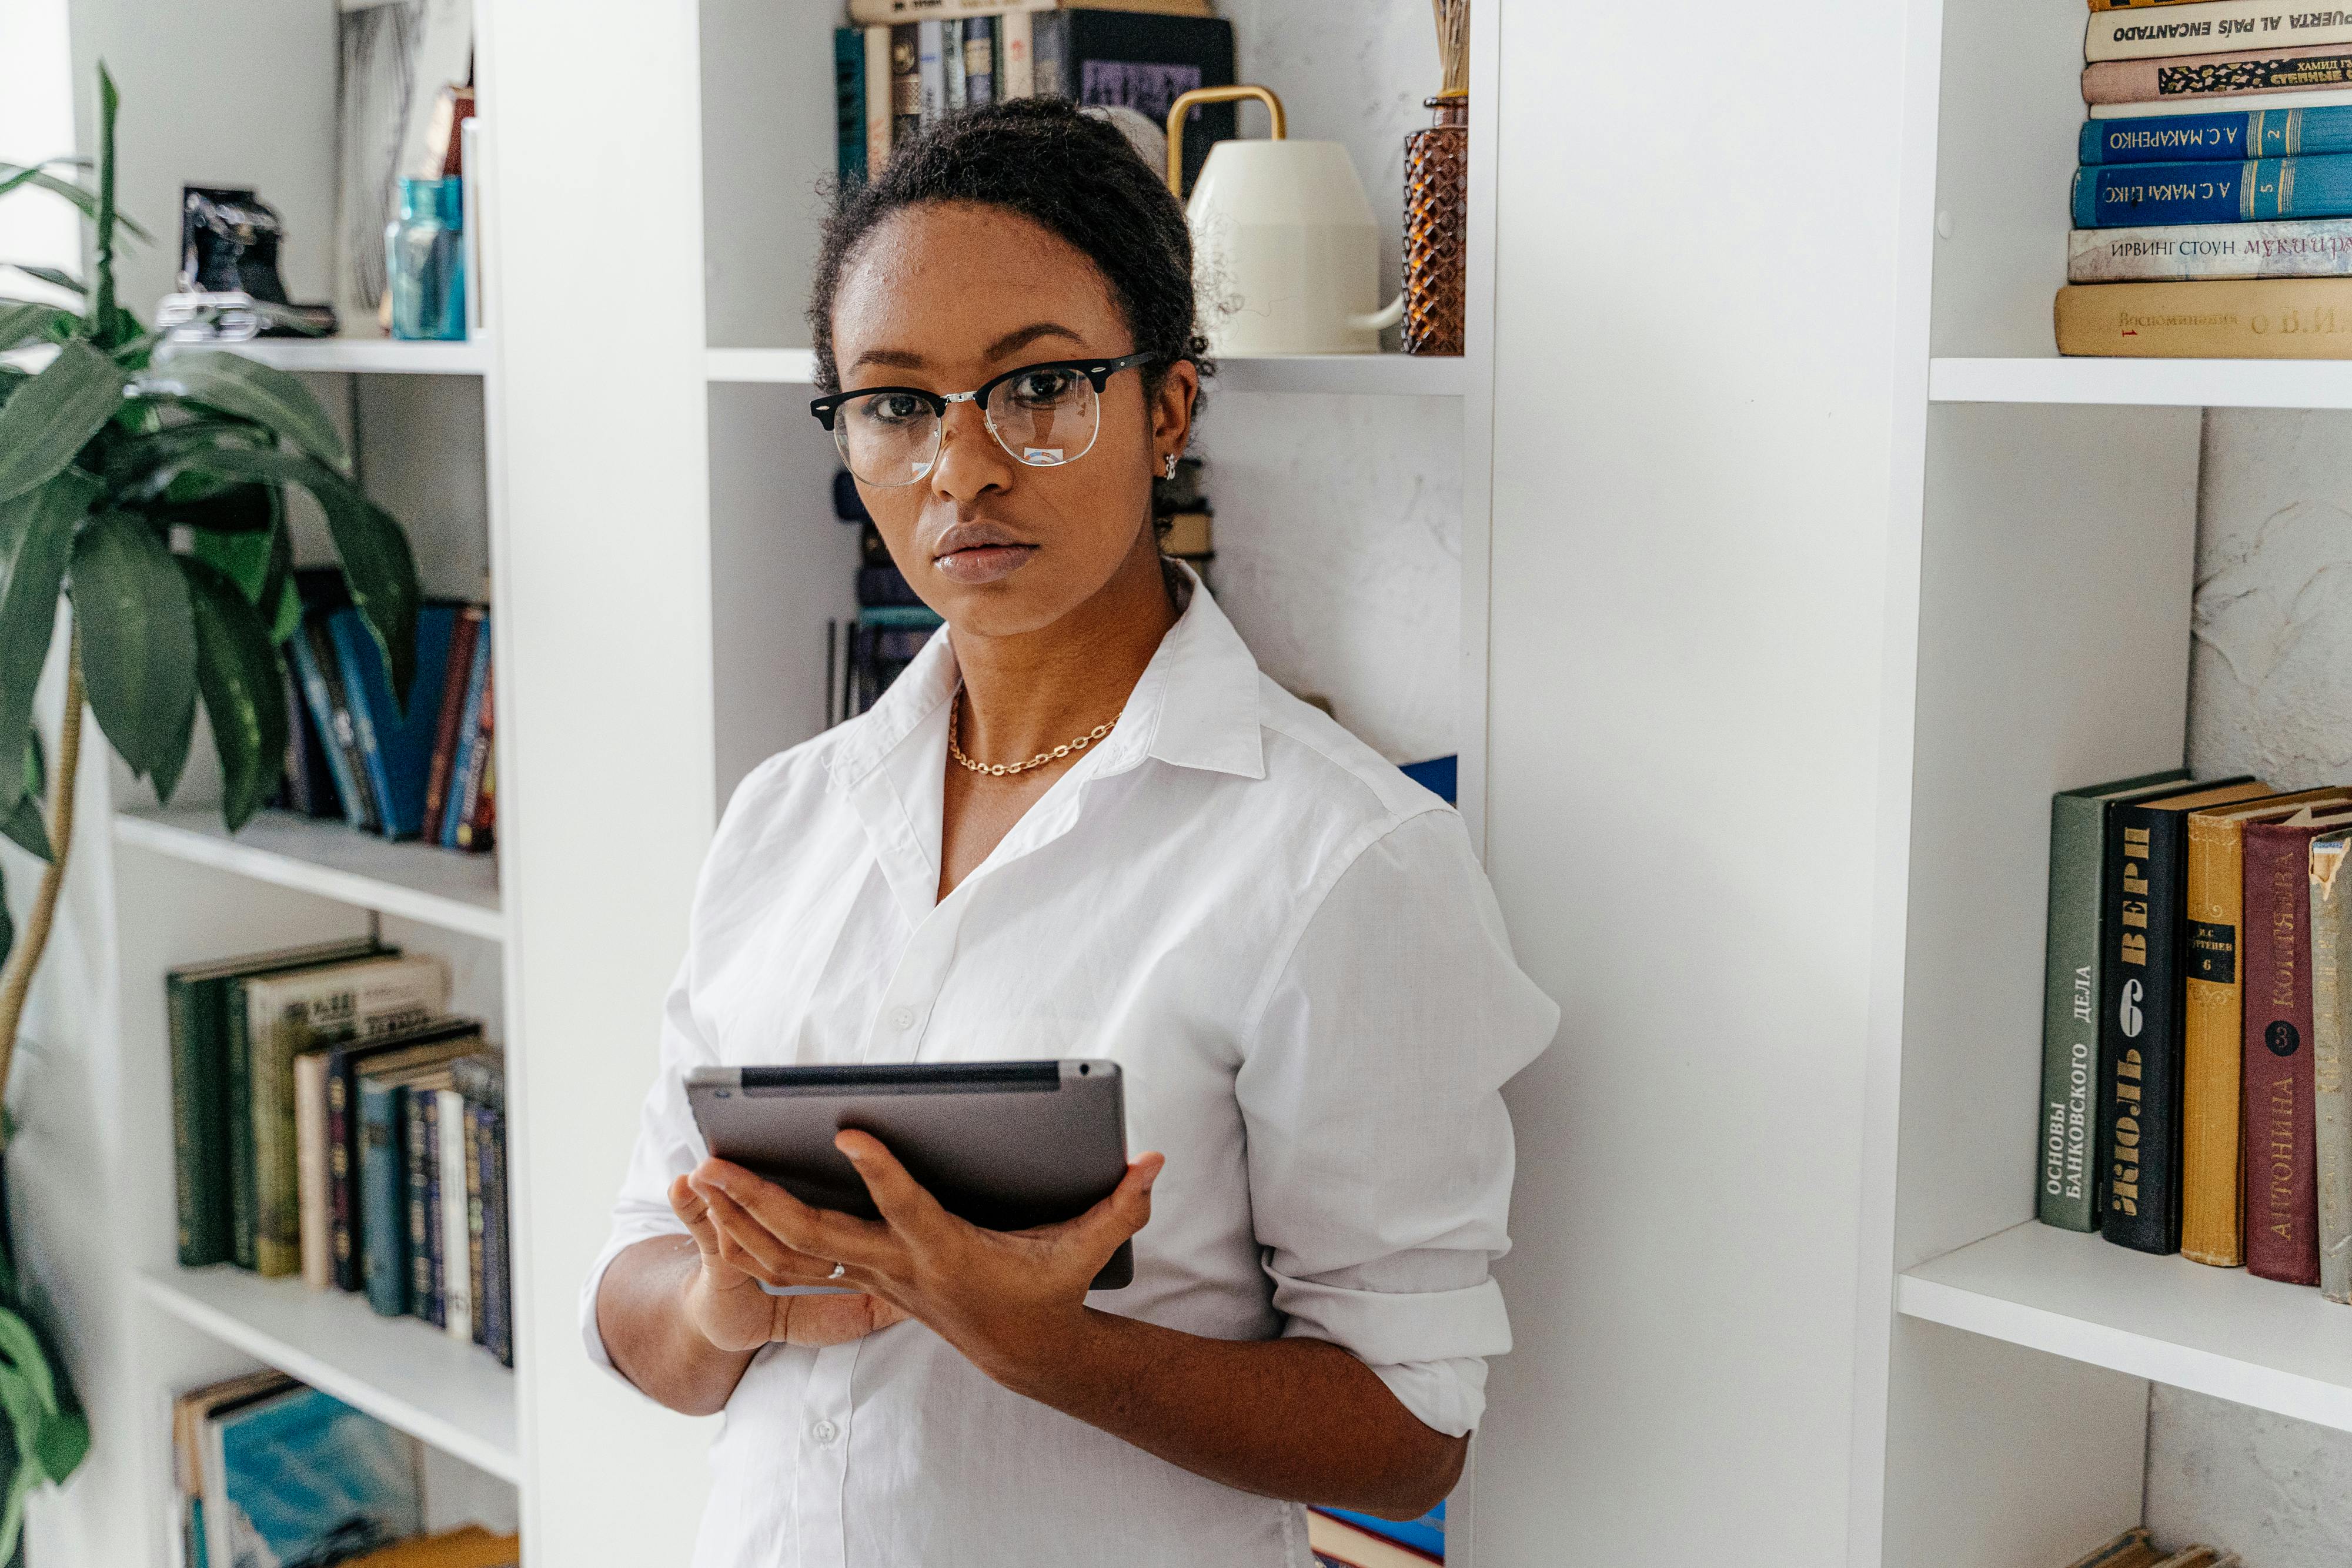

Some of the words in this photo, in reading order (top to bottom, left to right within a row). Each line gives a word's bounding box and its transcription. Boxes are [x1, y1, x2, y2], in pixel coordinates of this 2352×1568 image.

[2113, 21, 2212, 42] ENCANTADO
[2218, 18, 2255, 38] PAÍS
[2260, 15, 2282, 31] AL
[2110, 129, 2203, 149] МАКАРЕНКО
[2267, 130, 2280, 139] 2
[2260, 183, 2273, 193] 5
[2112, 241, 2176, 256] ИРВИНГ
[2180, 240, 2234, 256] СТОУН
[2121, 329, 2139, 337] 1
[2122, 827, 2150, 966] ВЕРН
[2202, 959, 2211, 971] 6
[2074, 965, 2092, 1024] ДЕЛА
[2119, 978, 2143, 1037] 6
[2276, 1027, 2287, 1047] 3
[2066, 1043, 2087, 1200] БАНКОВСКОГО
[2113, 1048, 2141, 1216] ЖЮЛЬ
[2047, 1103, 2066, 1195] ОСНОВЫ
[2271, 1077, 2294, 1241] АНТОНИНА
